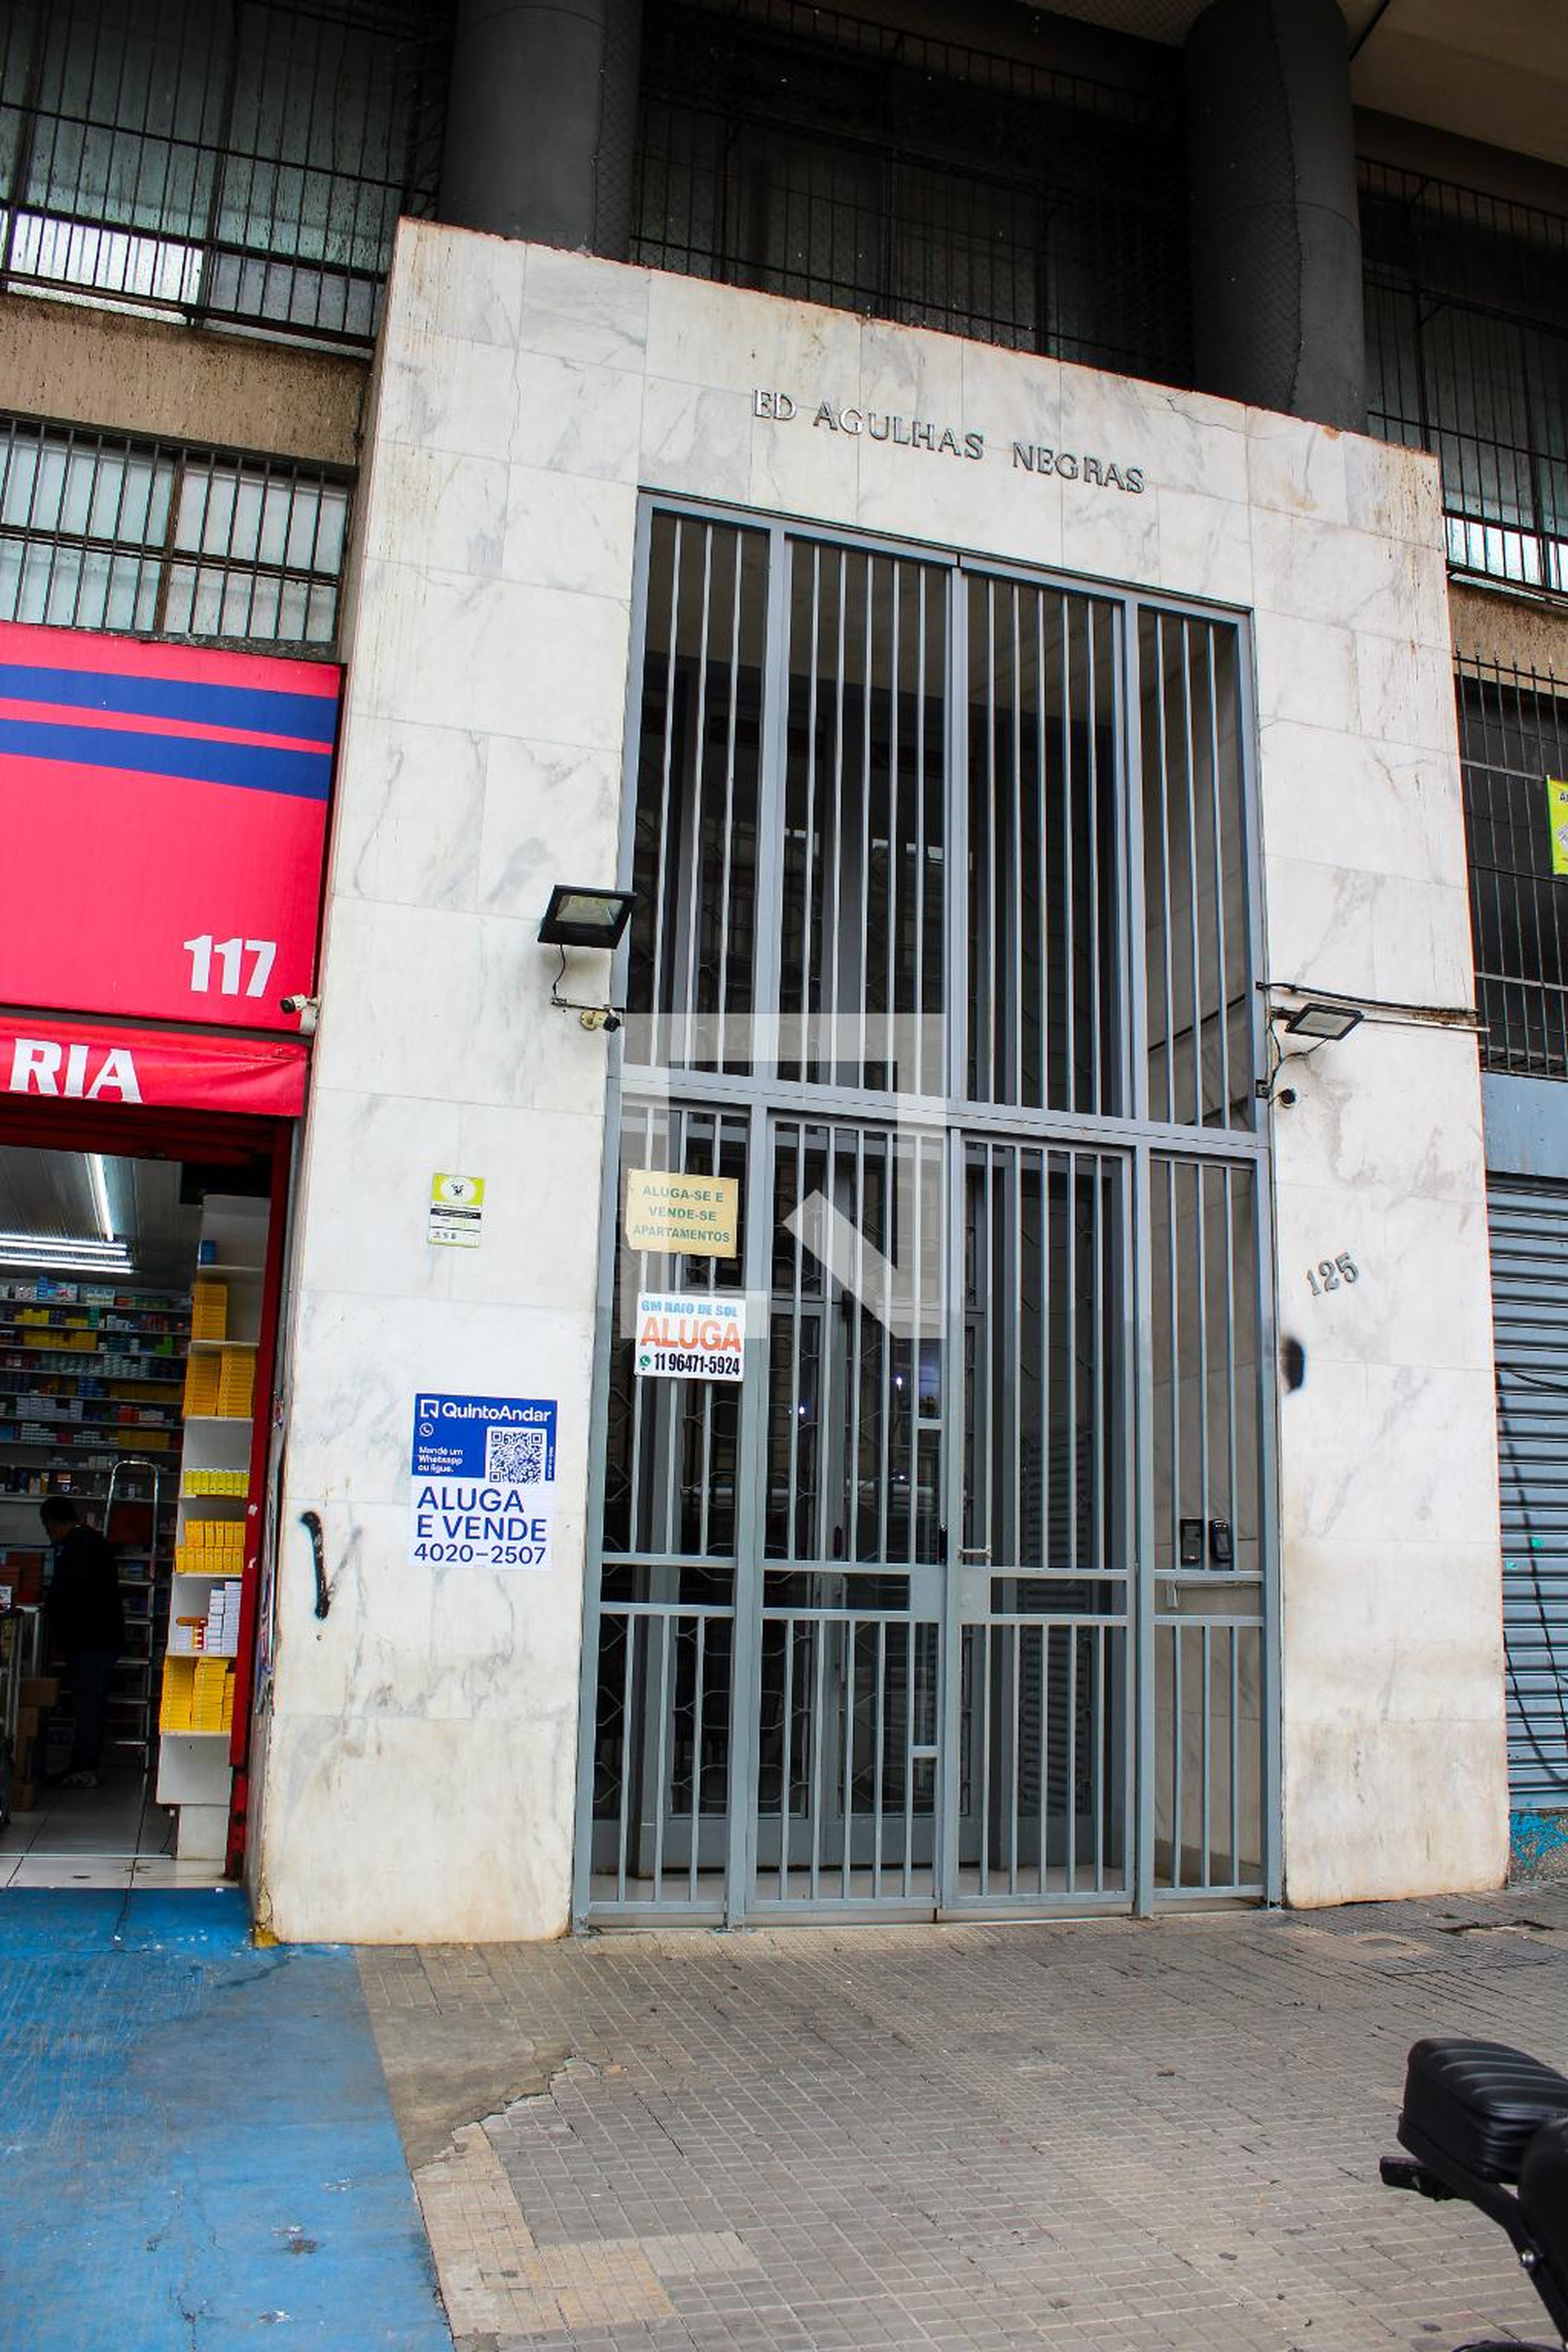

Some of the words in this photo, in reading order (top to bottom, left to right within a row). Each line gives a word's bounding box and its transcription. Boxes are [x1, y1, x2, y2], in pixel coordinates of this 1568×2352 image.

[751, 389, 796, 421] ED
[813, 400, 984, 460] AGULHAS
[1012, 441, 1145, 494] NEGRAS
[183, 935, 277, 998] 117
[9, 1038, 143, 1104] RIA
[642, 1185, 711, 1201] ALUGA-SE
[716, 1192, 724, 1203] E
[648, 1205, 717, 1221] VENDE-SE
[633, 1225, 731, 1243] APARTAMENTOS
[1307, 1252, 1359, 1296] 125
[697, 1304, 713, 1316] DE
[715, 1305, 738, 1317] SOL
[640, 1316, 742, 1352] ALUGA
[654, 1352, 666, 1371] 11
[669, 1353, 740, 1375] 96471-5924
[442, 1402, 552, 1422] QuintoAndar
[417, 1486, 524, 1513] ALUGA
[417, 1514, 434, 1538] E
[442, 1515, 547, 1542] VENDE
[414, 1543, 546, 1564] 4020-2507
